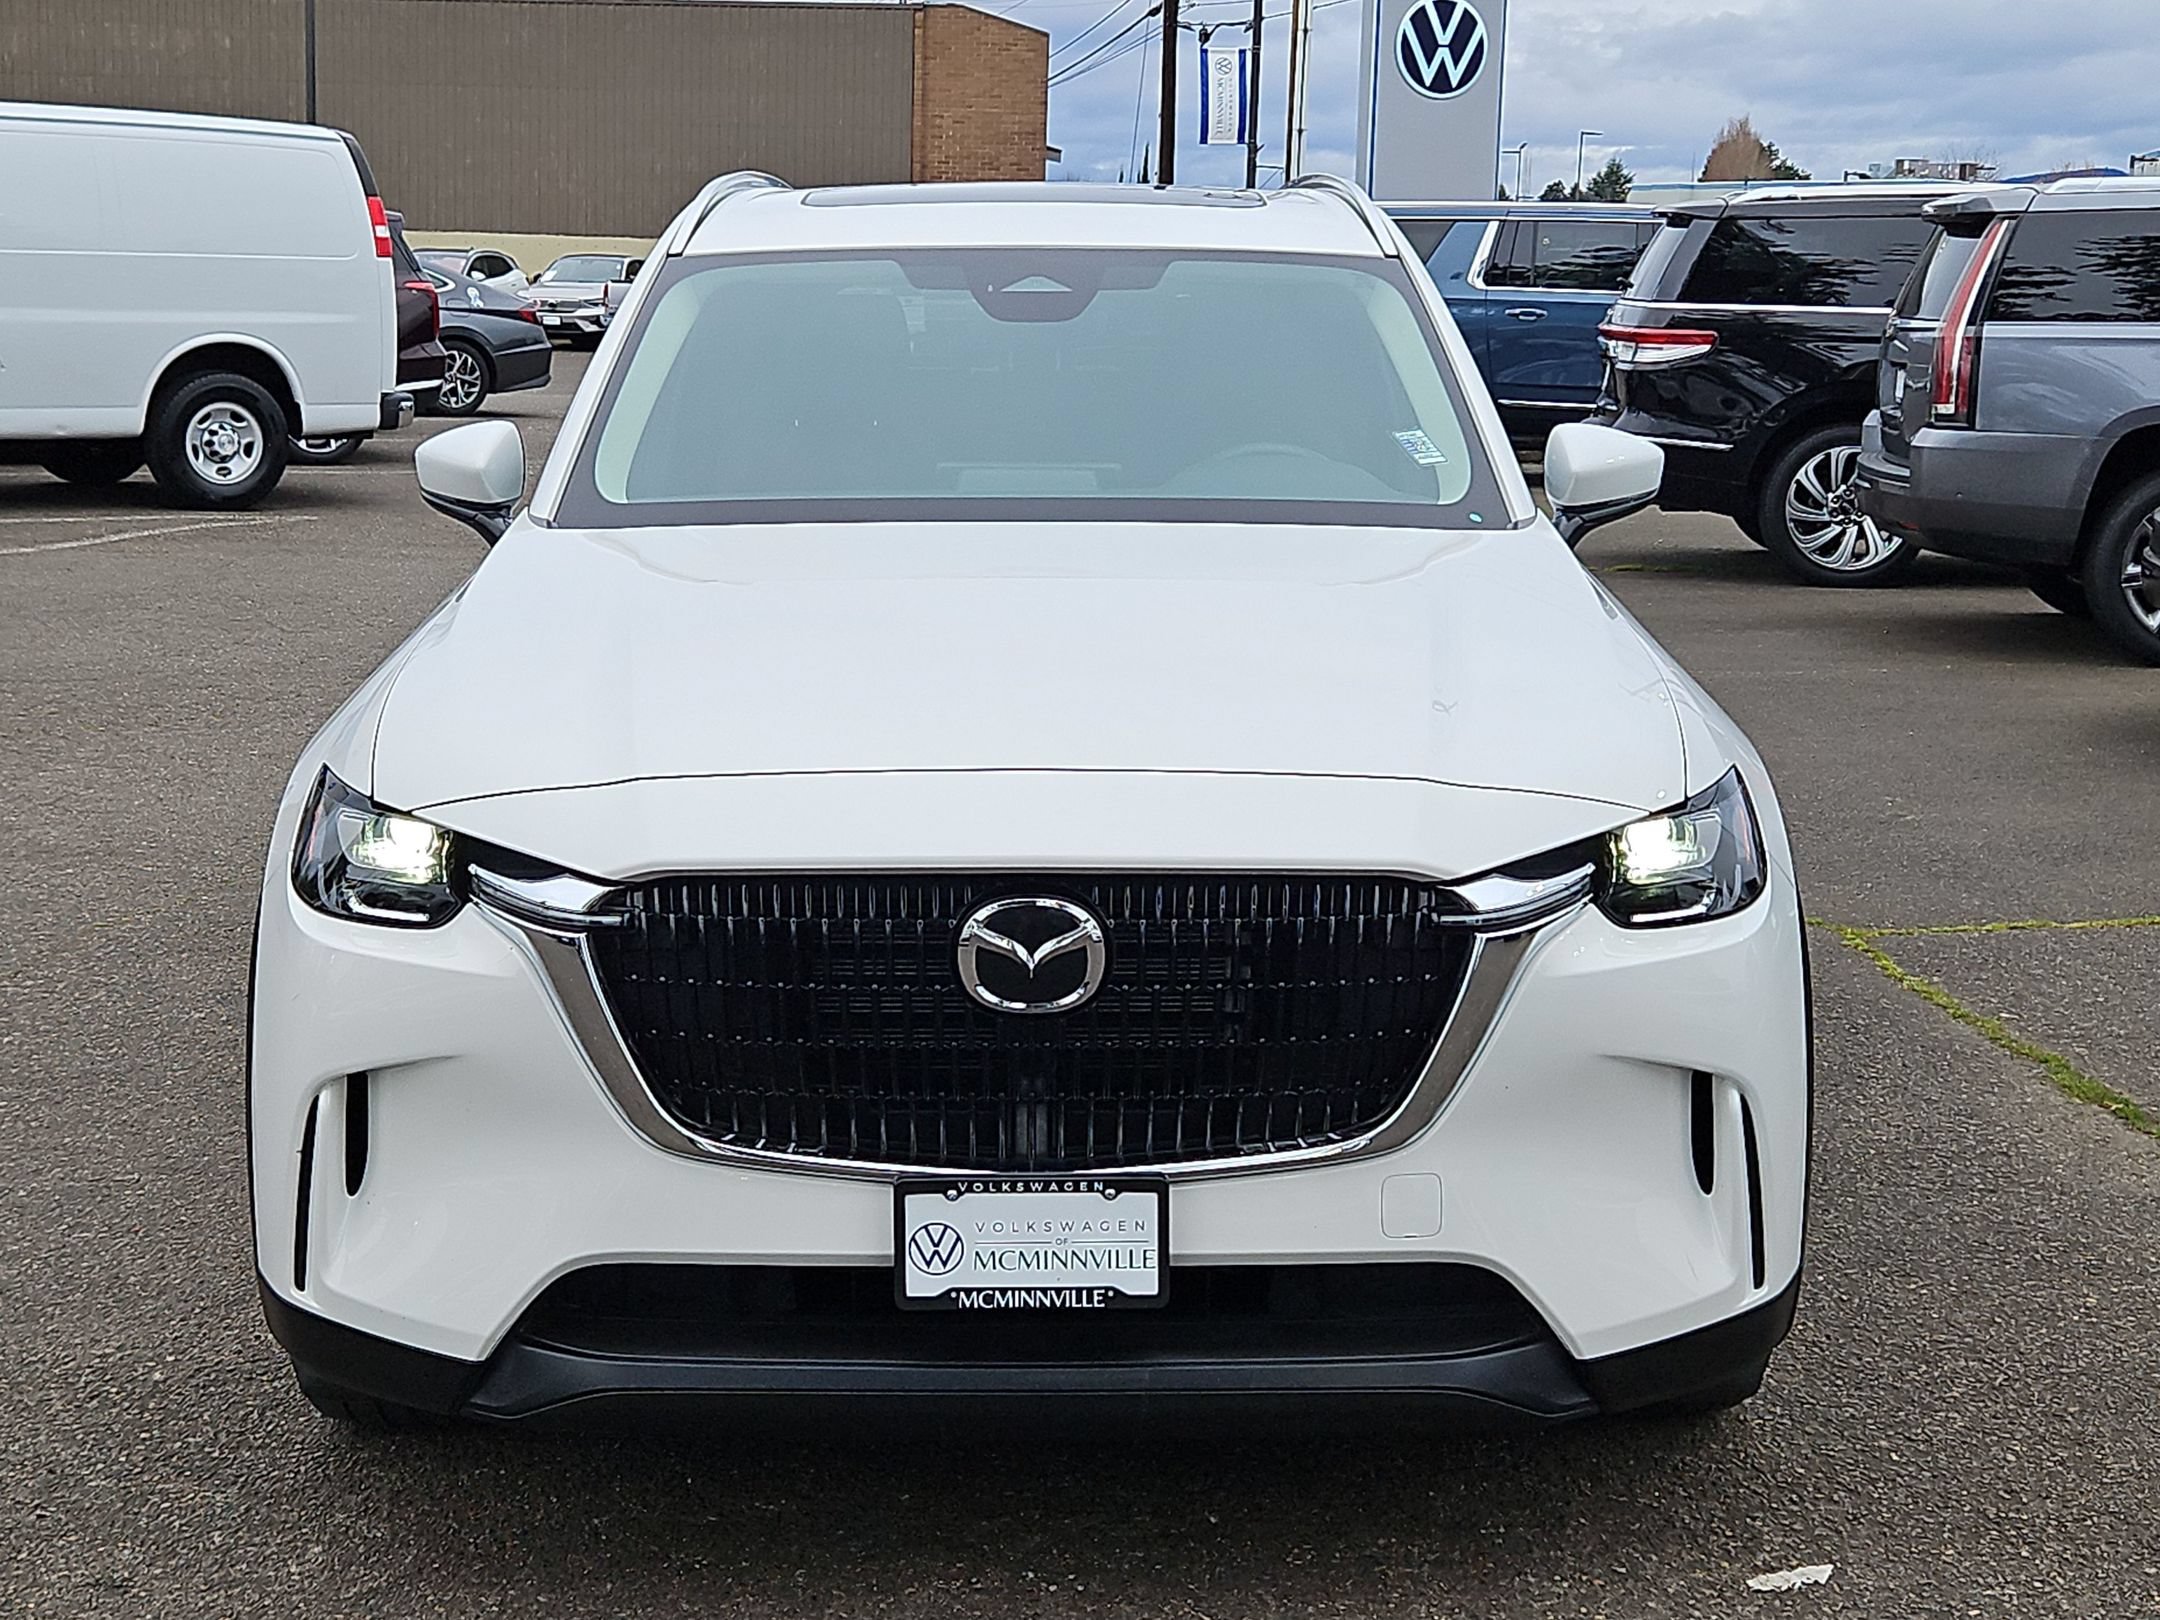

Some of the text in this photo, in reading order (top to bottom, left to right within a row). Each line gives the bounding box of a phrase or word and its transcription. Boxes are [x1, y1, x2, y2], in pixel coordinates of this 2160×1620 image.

[957, 1181, 1104, 1192] VOLKSWAGEN
[974, 1220, 1147, 1233] VOLKSWAGEN
[1055, 1237, 1069, 1246] OF
[973, 1249, 1157, 1271] MCMINNVILLE
[958, 1289, 1106, 1309] MCMINNVILLE
